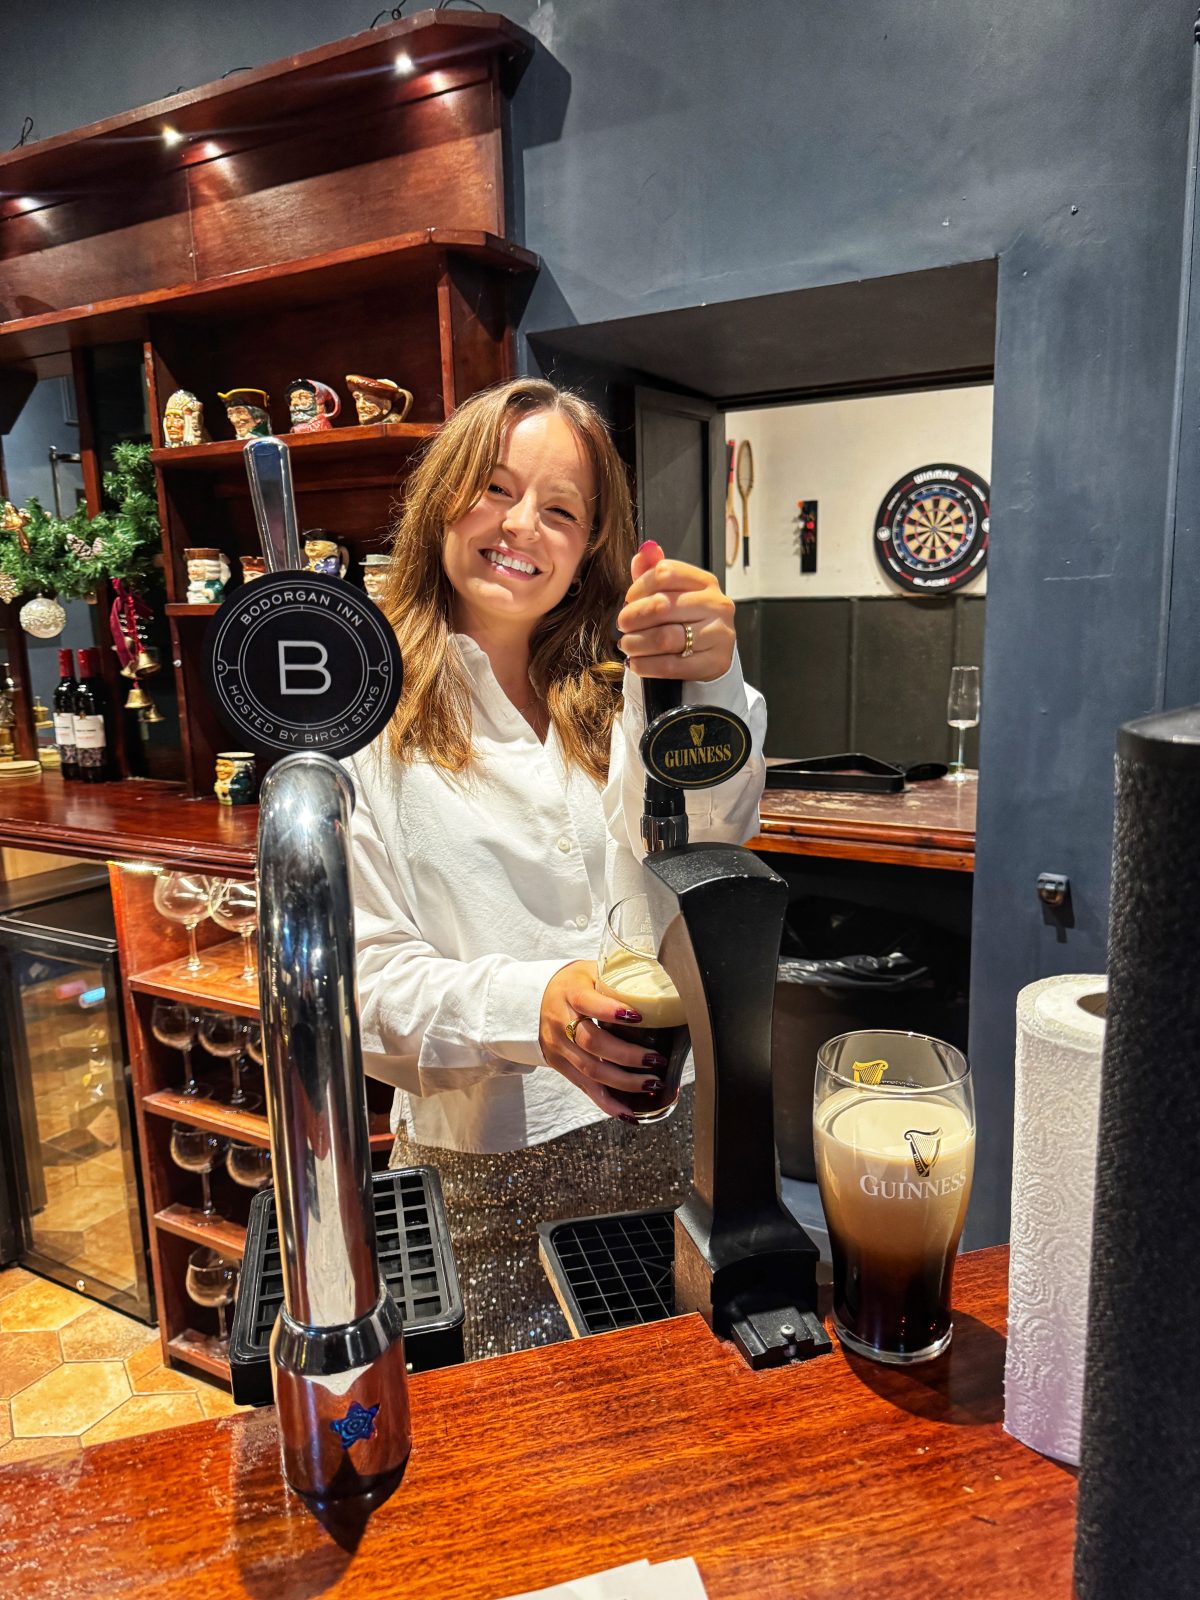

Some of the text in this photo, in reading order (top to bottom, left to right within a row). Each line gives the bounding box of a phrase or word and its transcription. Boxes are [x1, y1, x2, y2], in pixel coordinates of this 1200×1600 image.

[240, 590, 364, 627] BODORGAN INN
[277, 640, 332, 696] B
[228, 684, 380, 744] HOSTED BY BIRCH STAYS
[664, 743, 732, 769] GUINNESS
